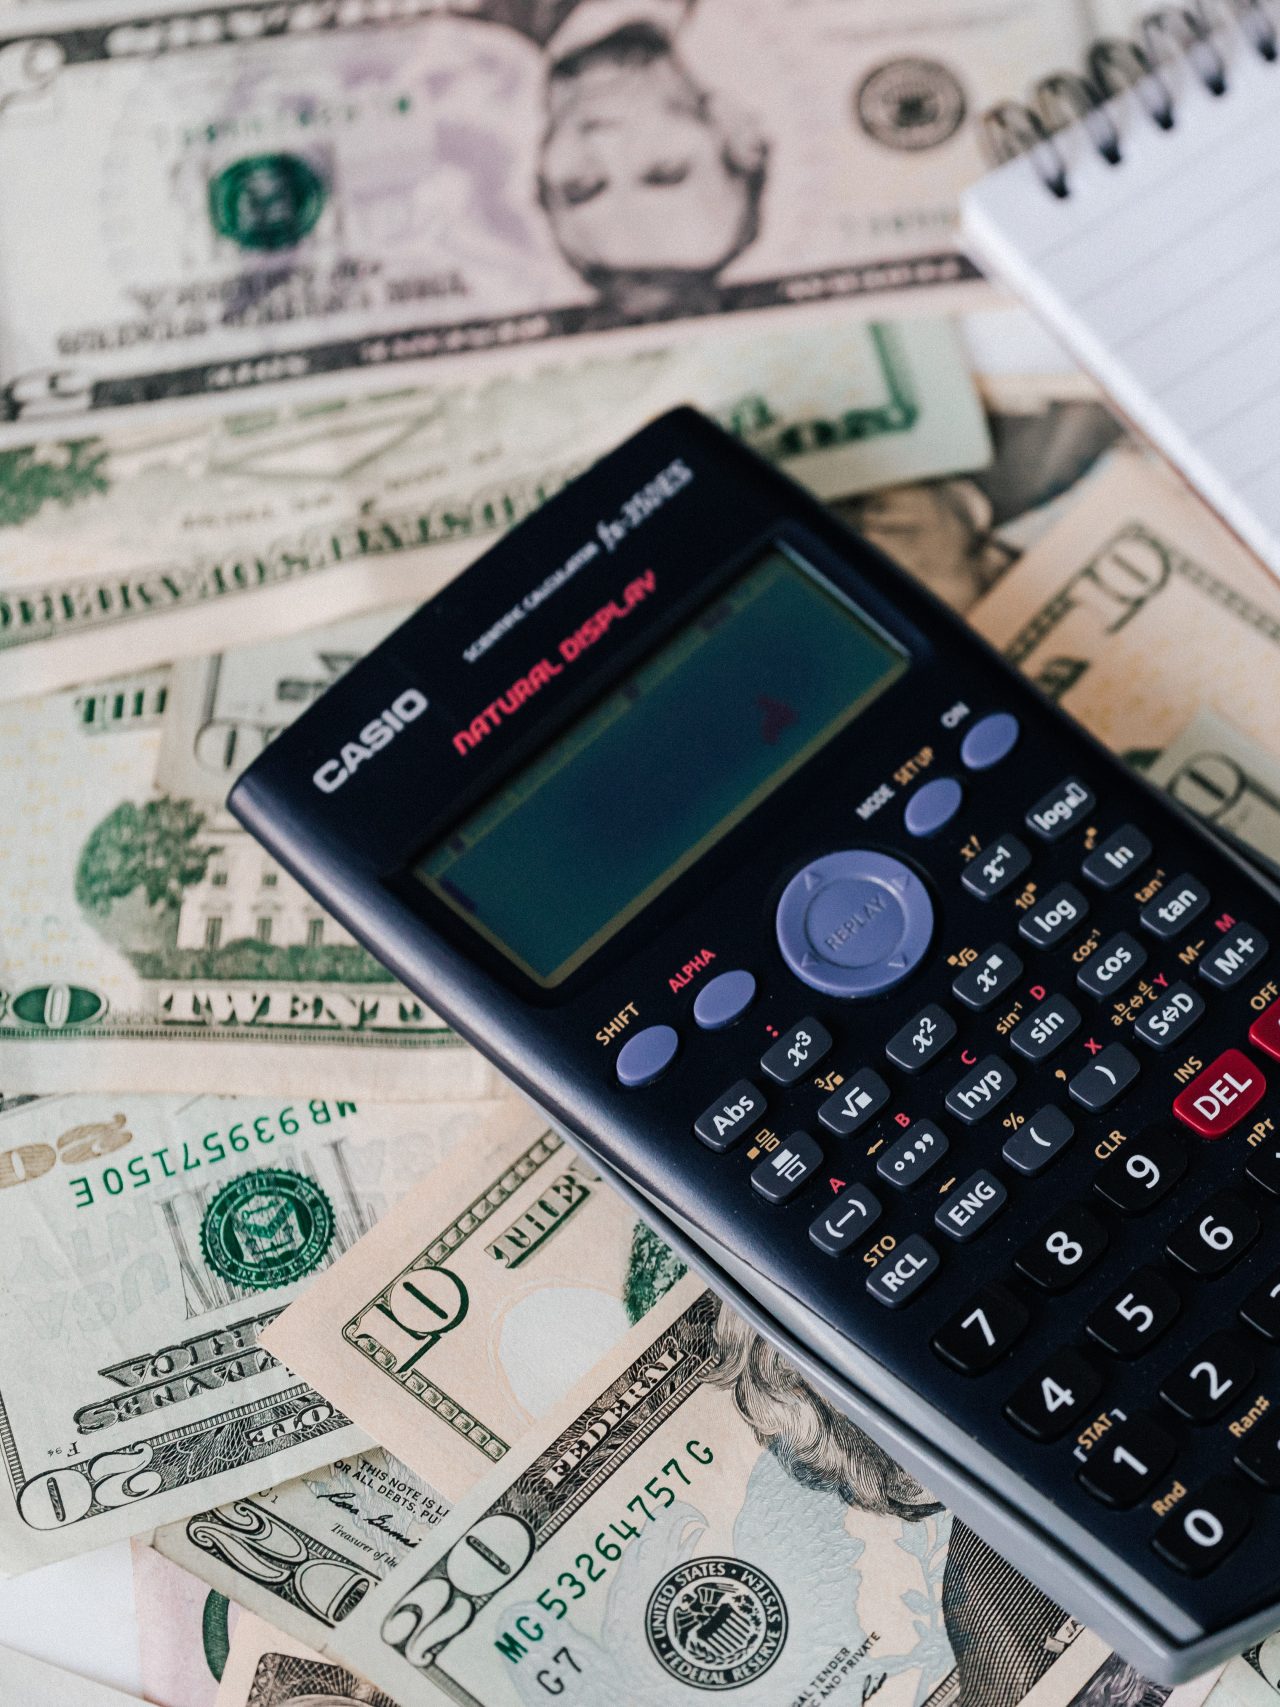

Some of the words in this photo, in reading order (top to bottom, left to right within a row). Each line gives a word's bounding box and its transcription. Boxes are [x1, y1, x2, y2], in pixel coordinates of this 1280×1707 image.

[452, 657, 564, 758] NATURAL
[557, 568, 658, 664] DISPLAY
[311, 687, 430, 795] CASIO
[1104, 845, 1135, 870] ln
[824, 893, 890, 953] REPLAY
[1034, 897, 1079, 935] log
[1157, 889, 1198, 923] tan
[1213, 912, 1237, 934] M
[667, 947, 717, 995] ALPHA
[1096, 946, 1133, 982] cos
[1152, 972, 1170, 988] Y
[159, 988, 452, 1033] TWENT
[1030, 984, 1047, 1001] D
[1250, 981, 1280, 1011] OFF
[595, 1001, 641, 1047] SHIFT
[1029, 1008, 1065, 1046] sin
[961, 1049, 978, 1066] C
[1173, 1055, 1204, 1085] INS
[957, 1067, 1004, 1114] hyp
[1192, 1071, 1254, 1122] DEL
[711, 1093, 755, 1137] Abs
[896, 1112, 911, 1128] B
[1246, 1116, 1277, 1148] nPr
[104, 1105, 301, 1196] 93957150
[1094, 1129, 1128, 1162] CLR
[68, 1175, 96, 1208] E
[829, 1176, 847, 1194] A
[1125, 1153, 1162, 1190] 9
[484, 1167, 593, 1269] THE
[947, 1181, 997, 1227] ENG
[863, 1234, 897, 1268] STO
[1044, 1230, 1084, 1266] 8
[1198, 1215, 1235, 1251] 6
[881, 1252, 929, 1293] RCL
[960, 1308, 997, 1347] 7
[1115, 1293, 1155, 1333] 5
[97, 1316, 264, 1388] RICA
[72, 1347, 284, 1436] TATES
[1039, 1375, 1076, 1414] 4
[1189, 1361, 1234, 1400] 2
[243, 1400, 336, 1448] OTE
[543, 1344, 688, 1489] FEDERAL
[333, 1459, 352, 1475] OR
[351, 1470, 375, 1489] ALL
[1112, 1445, 1150, 1476] 1
[16, 1440, 165, 1531] 20
[360, 1459, 389, 1482] THIS
[388, 1476, 422, 1502] NOTE
[421, 1497, 436, 1510] IS
[1151, 1480, 1189, 1518] Rnd
[331, 1521, 373, 1554] Treasurer
[373, 1549, 387, 1562] of
[1183, 1508, 1225, 1548] 0
[493, 1614, 545, 1665] MG
[536, 1456, 692, 1622] 53264757
[685, 1439, 715, 1466] G
[380, 1511, 537, 1669] 20
[651, 1584, 678, 1640] UNITED
[673, 1562, 727, 1588] STATES
[740, 1568, 782, 1624] SYSTEM
[536, 1646, 583, 1697] G7
[663, 1650, 728, 1686] FEDERAL
[731, 1628, 783, 1683] RESERVE
[811, 1646, 852, 1692] TENDER
[820, 1674, 843, 1700] AND
[841, 1630, 882, 1676] PRIVATE
